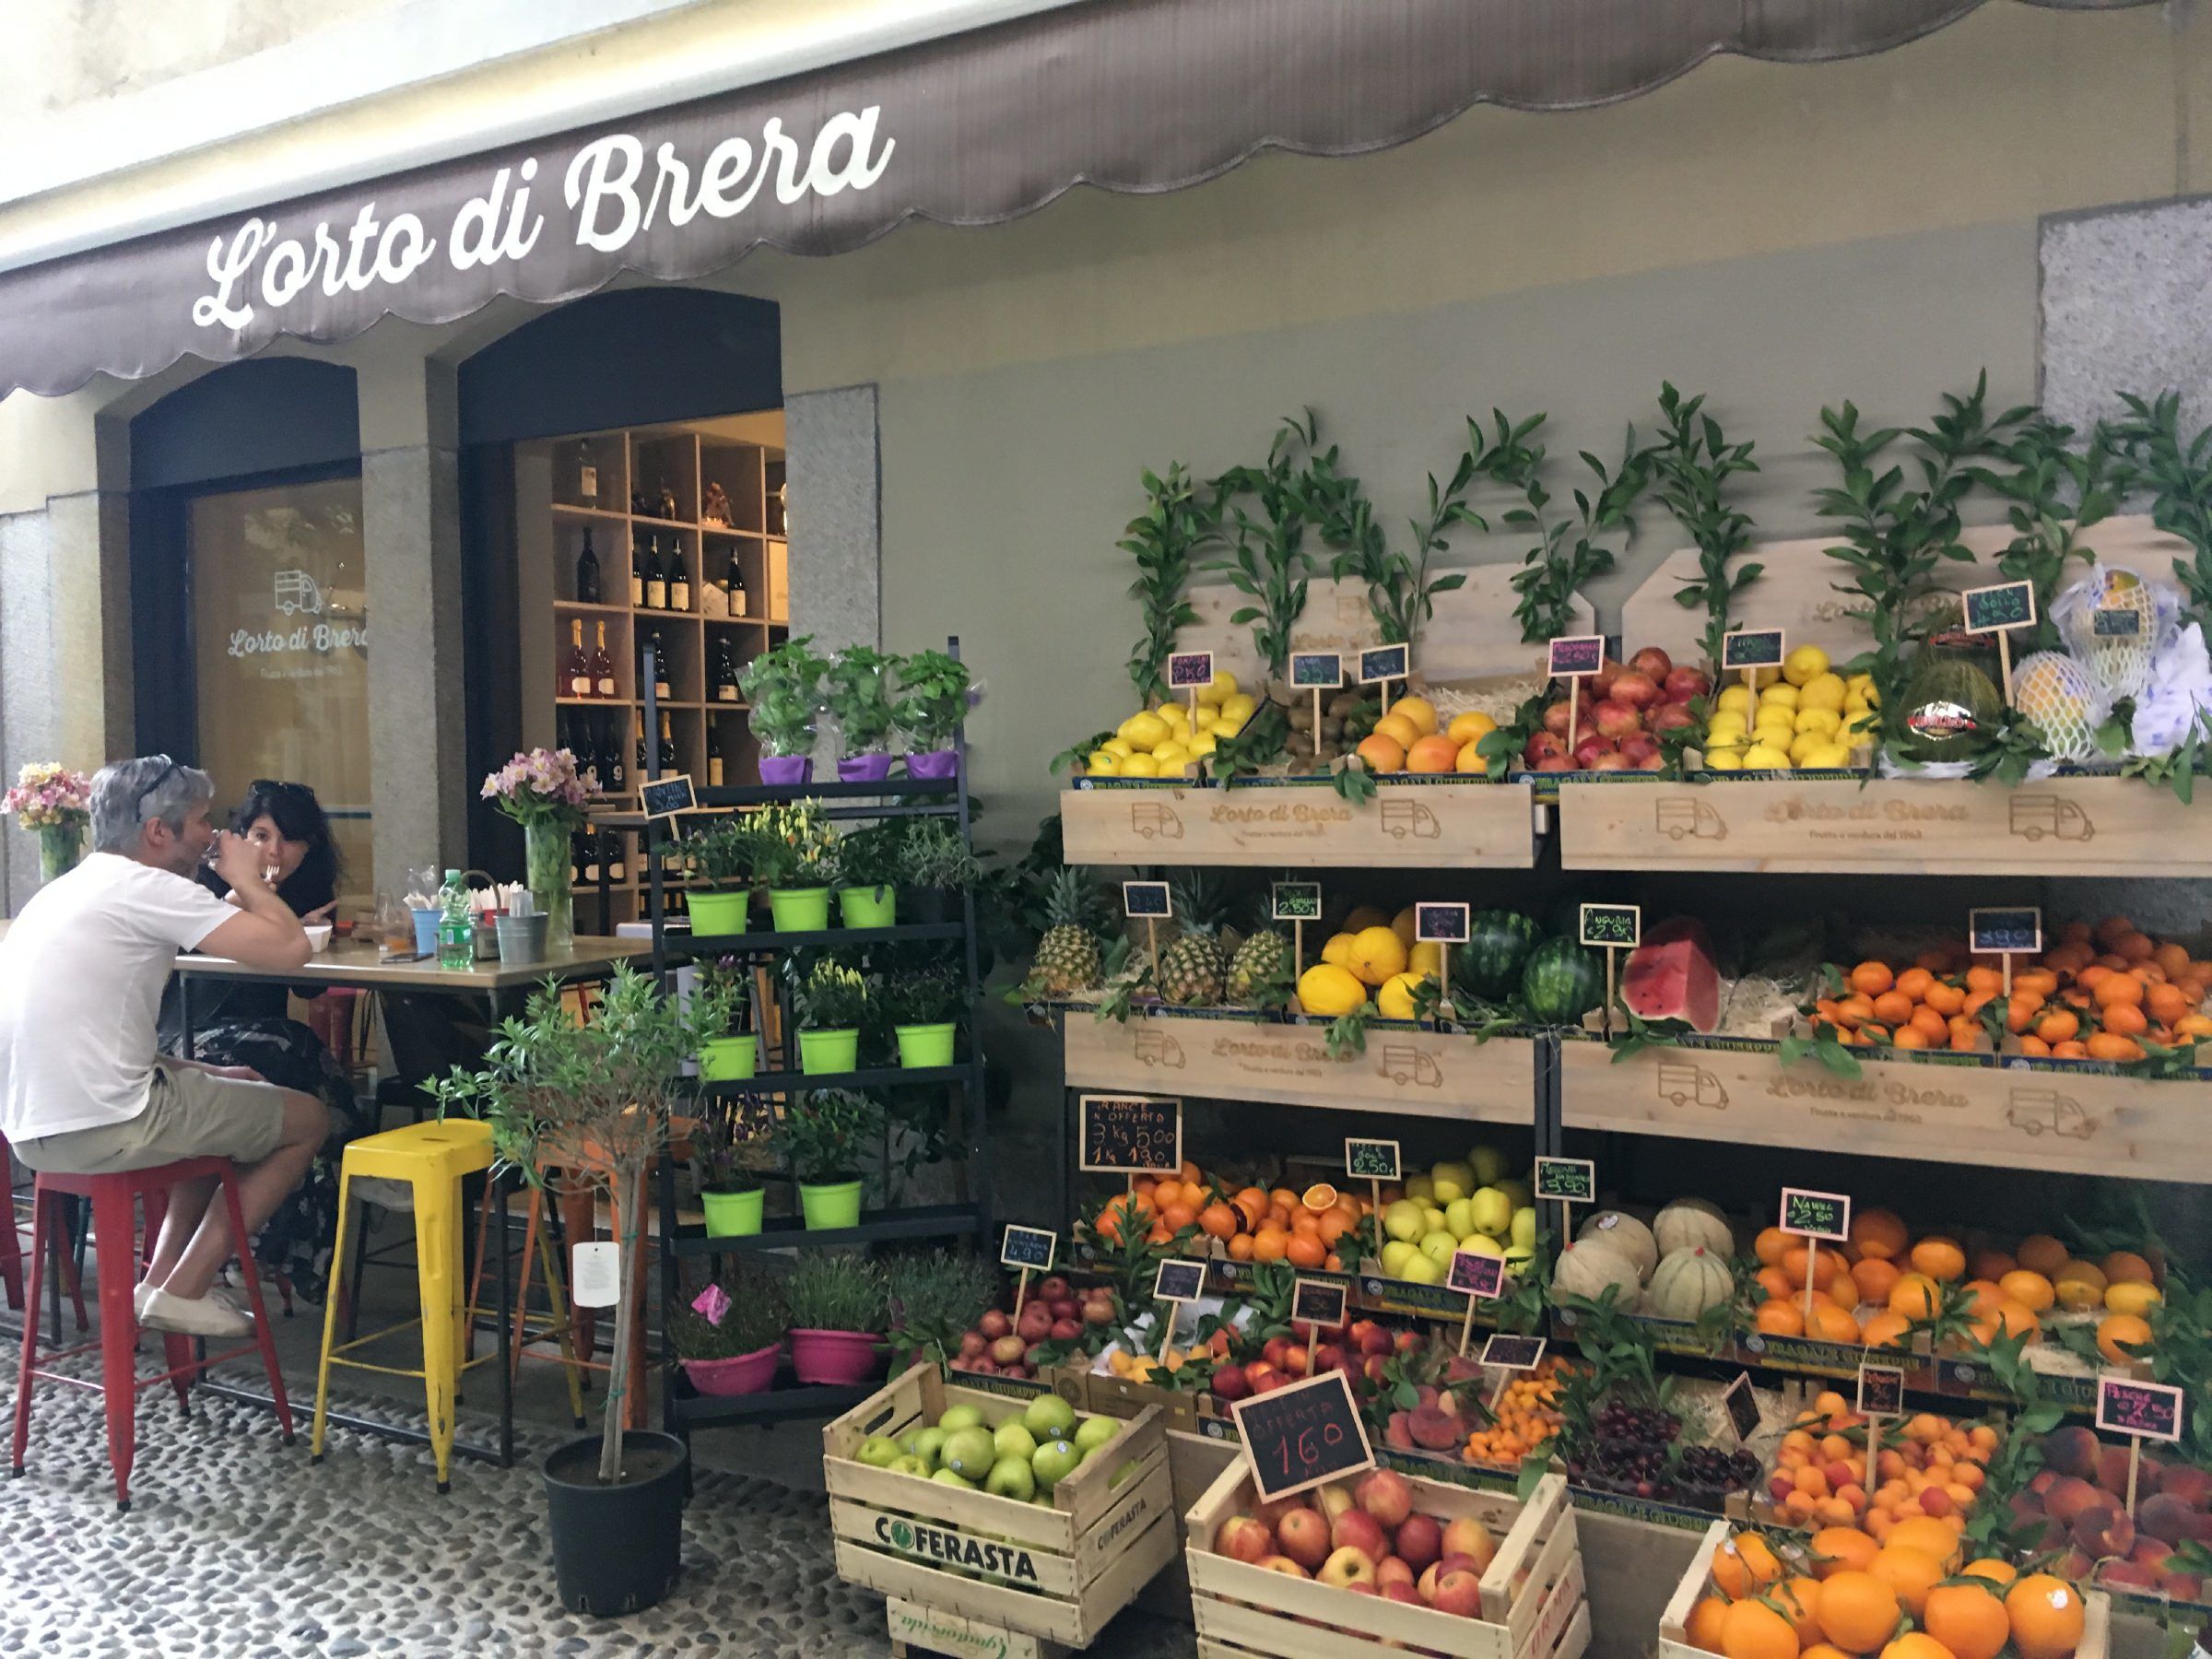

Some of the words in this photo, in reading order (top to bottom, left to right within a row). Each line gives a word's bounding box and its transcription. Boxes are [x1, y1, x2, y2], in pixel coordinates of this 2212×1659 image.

[193, 202, 437, 331] L'orto
[449, 157, 546, 271] di
[564, 105, 896, 253] Brera
[289, 627, 309, 650] di
[1268, 804, 1290, 822] di
